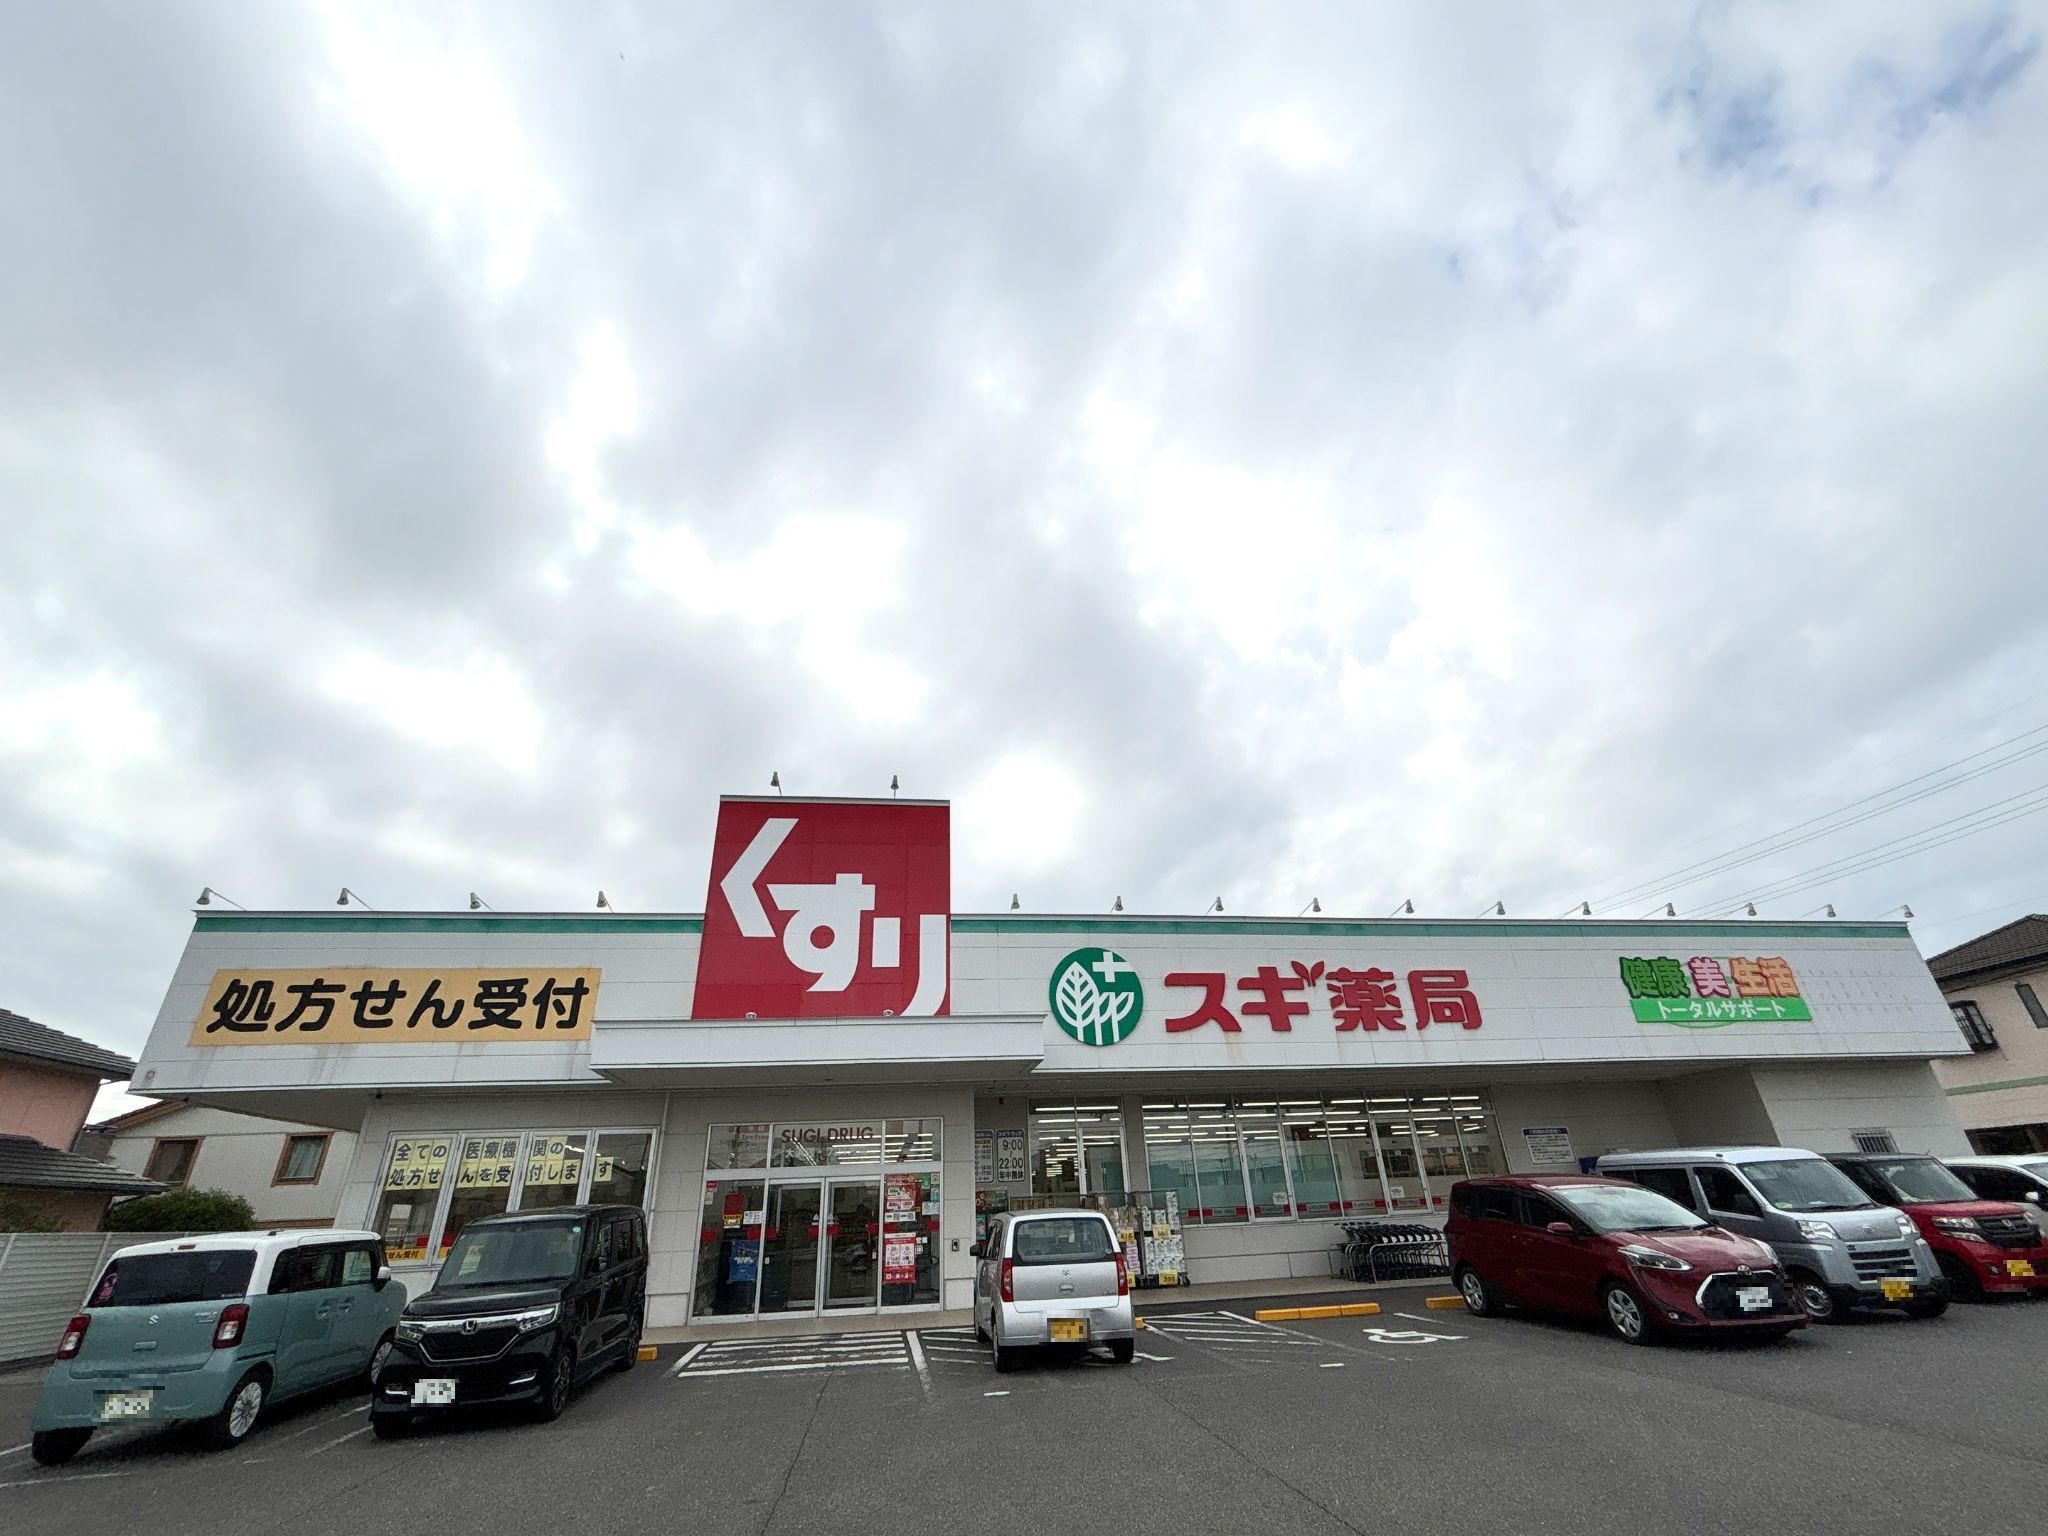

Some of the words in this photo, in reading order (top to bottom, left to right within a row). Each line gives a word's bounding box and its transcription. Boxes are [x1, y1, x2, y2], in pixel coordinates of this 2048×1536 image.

[720, 817, 948, 1017] くすり
[1164, 960, 1483, 1032] スギ薬局
[206, 977, 590, 1033] 処方せん受付
[1657, 1001, 1785, 1019] トータルサポート
[781, 1128, 821, 1143] SUGI
[827, 1126, 874, 1141] DRUG
[1002, 1139, 1024, 1151] 9:00
[998, 1157, 1024, 1170] 22:00
[386, 1250, 420, 1259] せん受付
